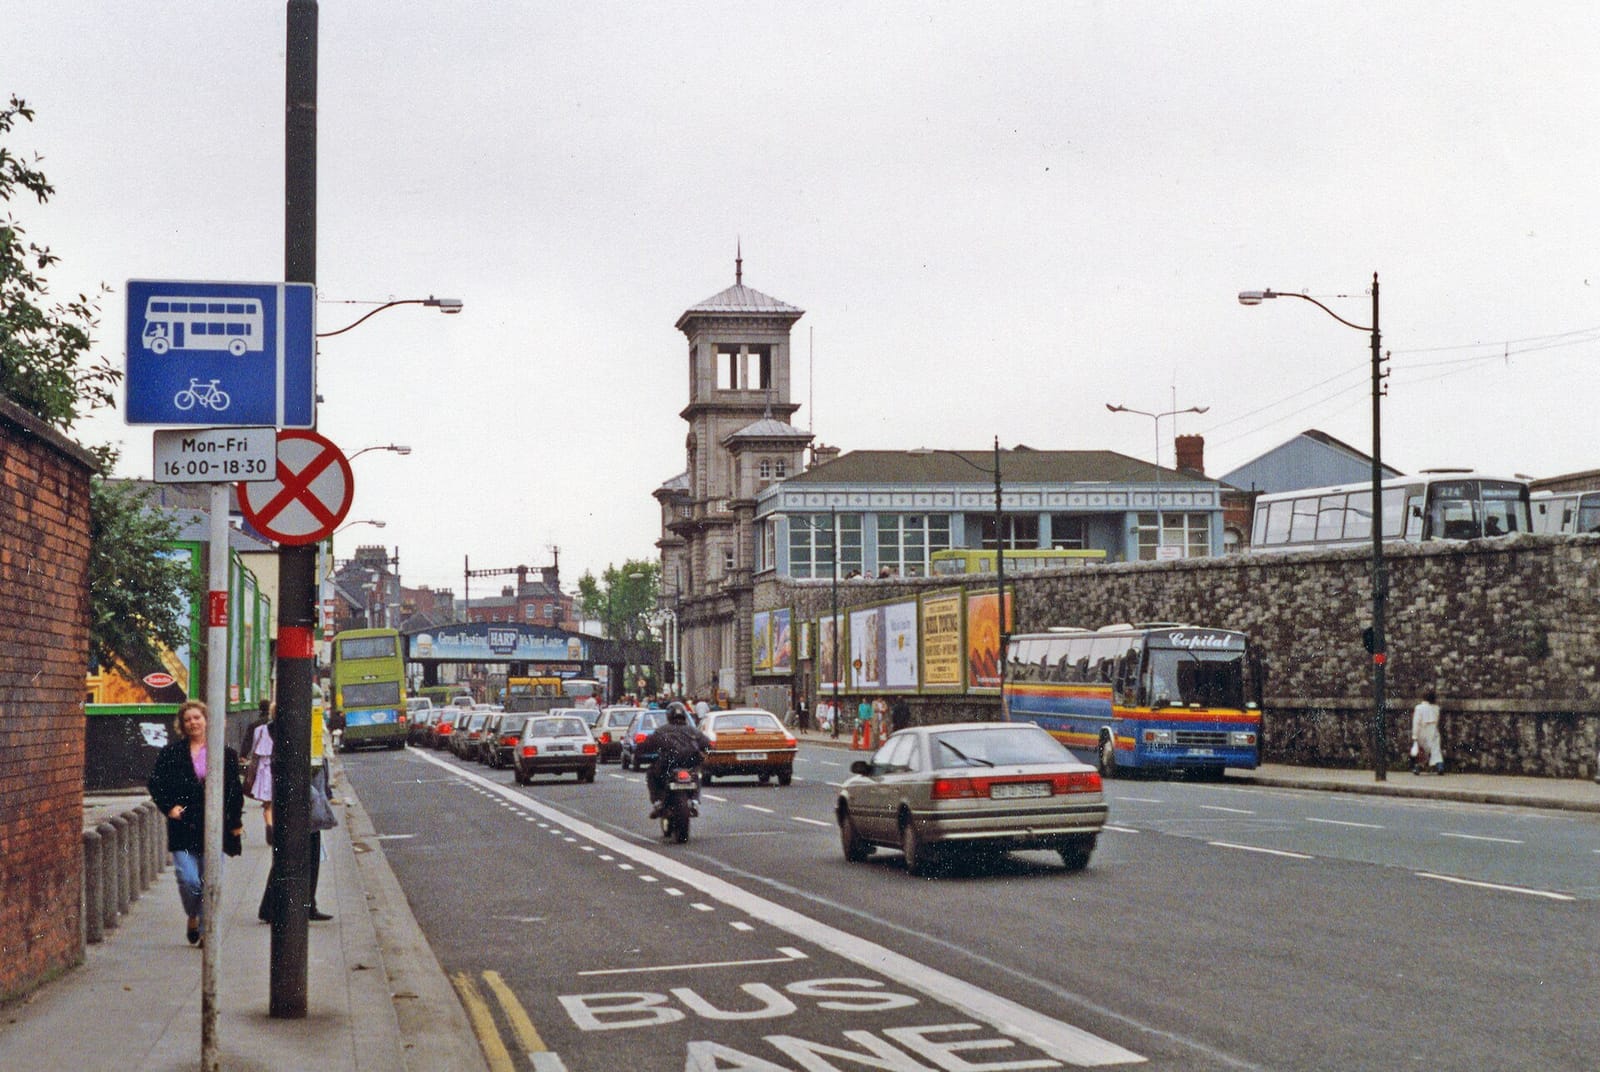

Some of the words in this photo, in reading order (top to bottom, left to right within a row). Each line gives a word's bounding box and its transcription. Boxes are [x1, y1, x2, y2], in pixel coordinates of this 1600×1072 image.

[181, 438, 248, 453] Mon-Fri
[490, 632, 516, 646] HARP
[1169, 632, 1231, 649] Capital
[557, 976, 920, 1032] BUS
